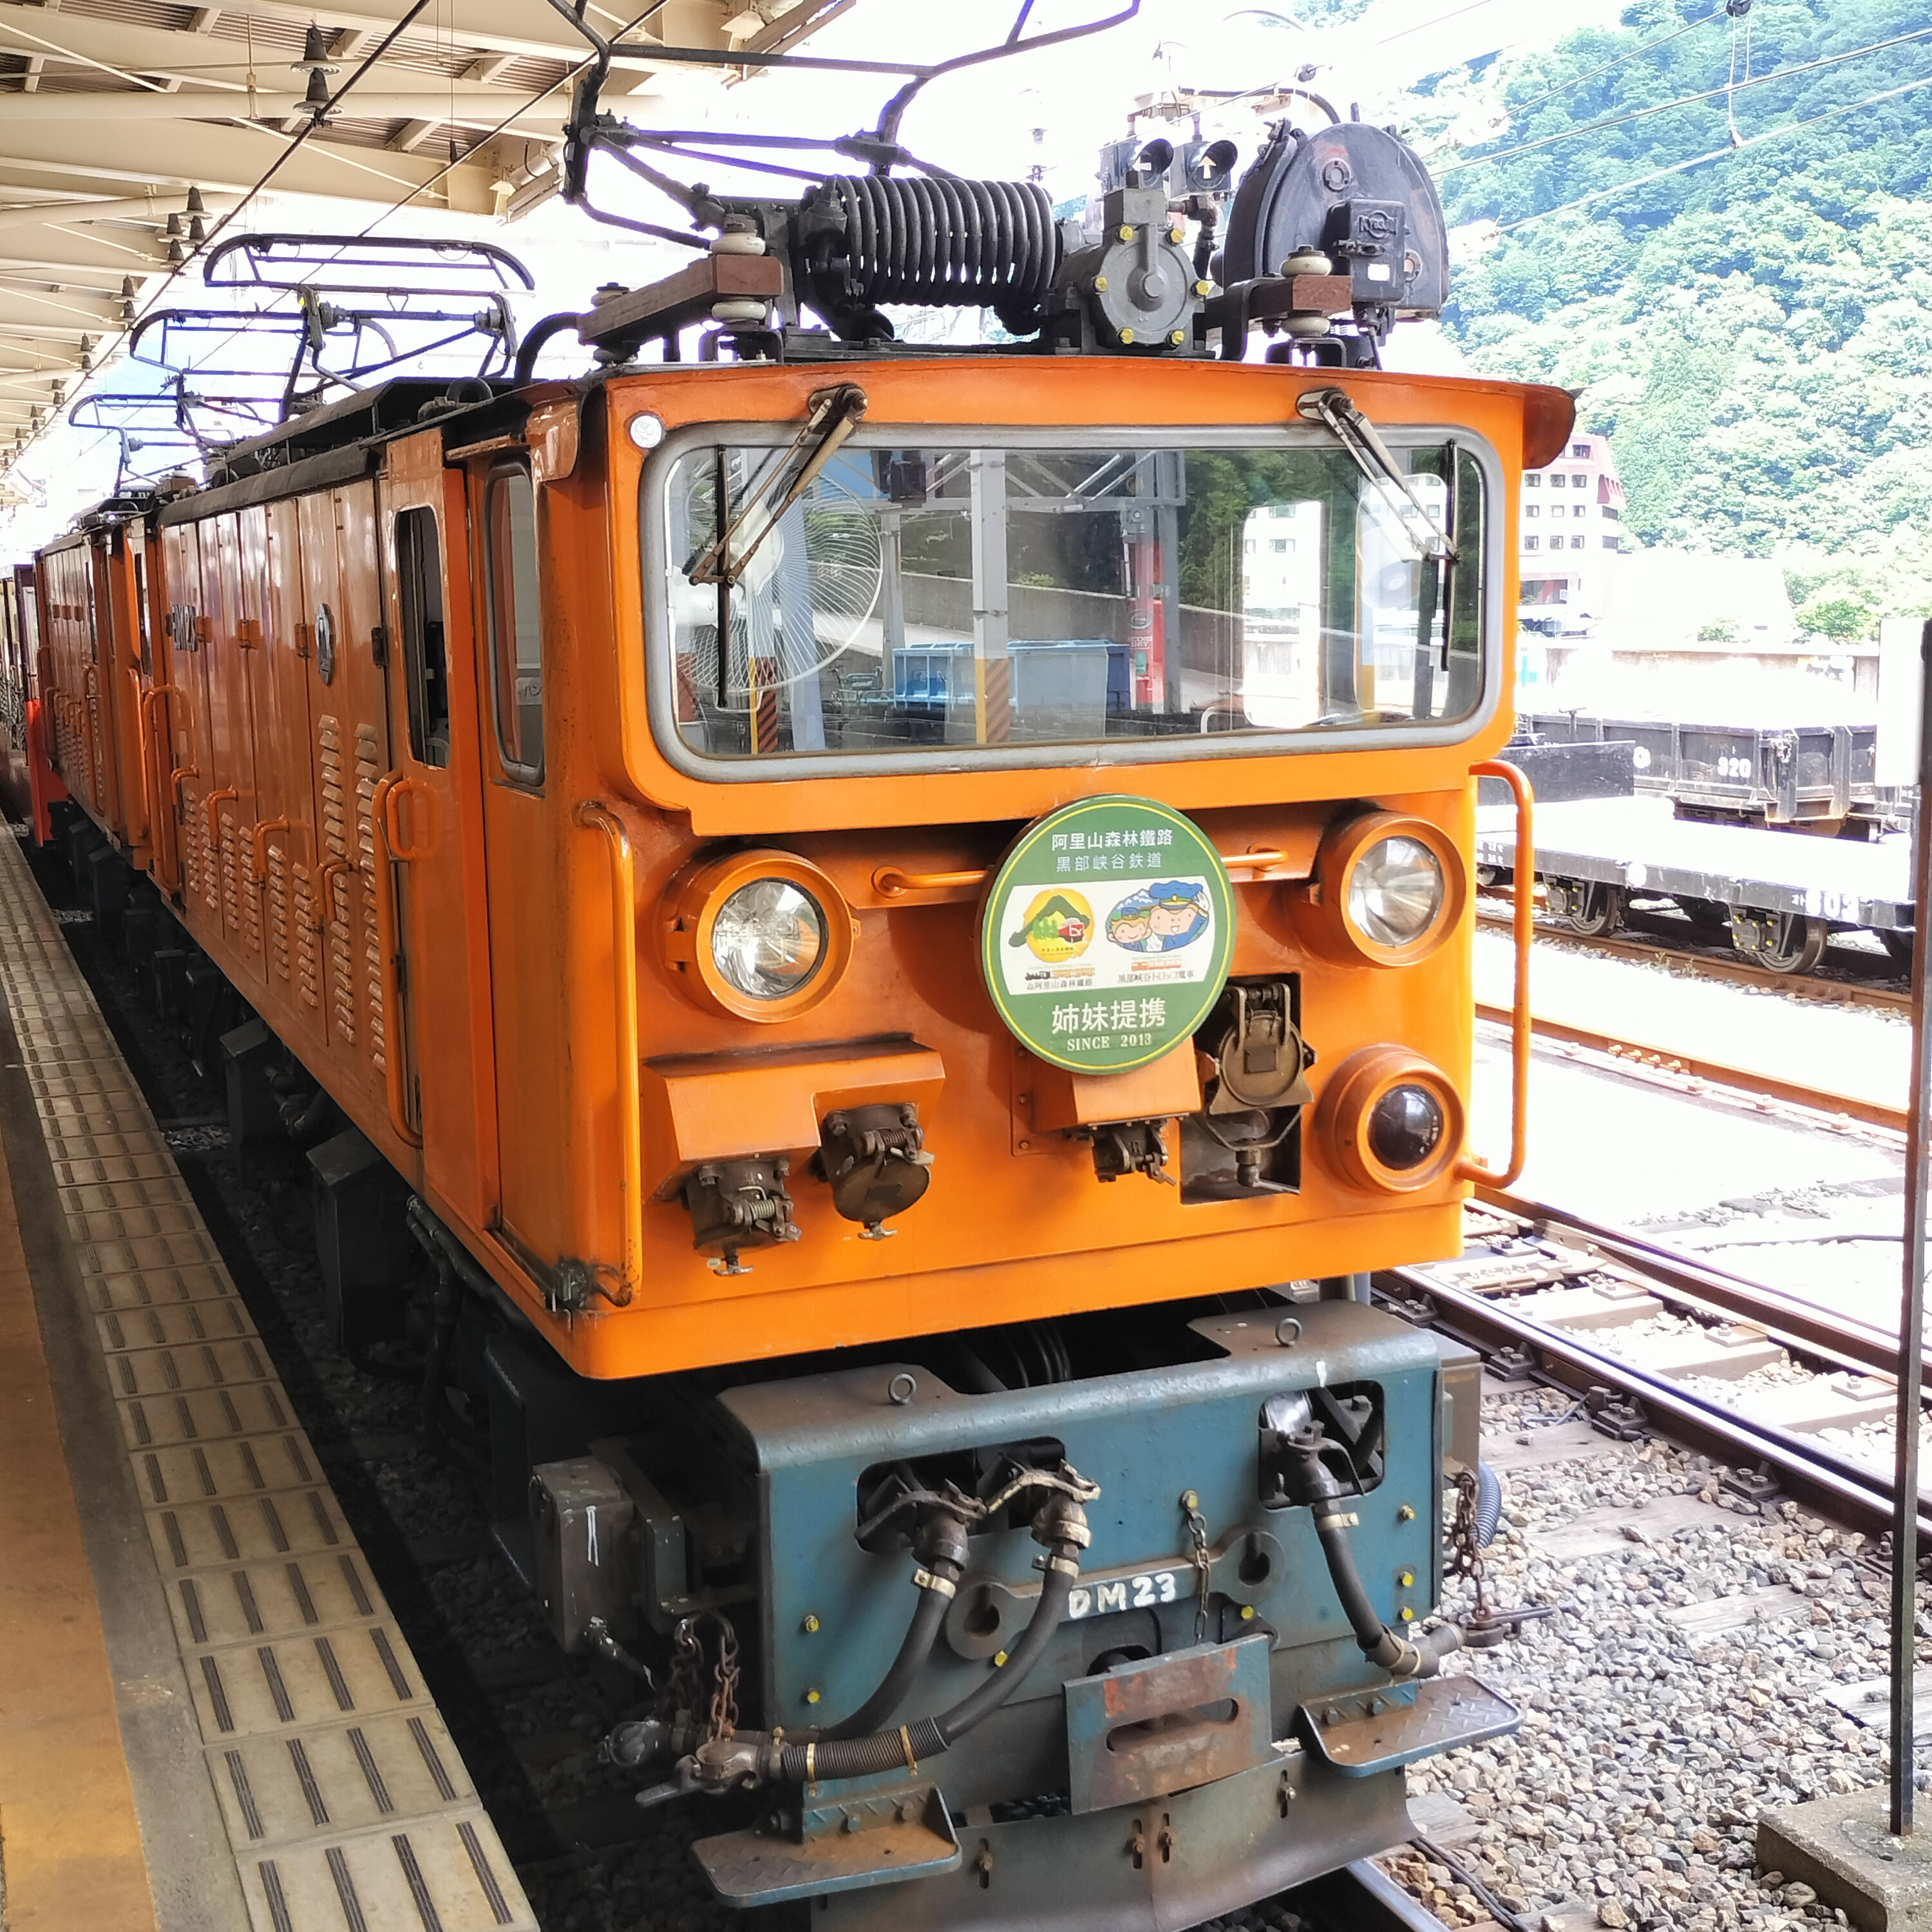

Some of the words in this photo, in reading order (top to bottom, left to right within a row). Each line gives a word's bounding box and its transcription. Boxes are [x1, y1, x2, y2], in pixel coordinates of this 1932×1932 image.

[1052, 829, 1173, 851] 阿里山森林鐵路
[1056, 852, 1162, 873] 黒部峡谷鉄道
[1052, 997, 1166, 1034] 姉妹提携
[1066, 1036, 1110, 1052] SINCE
[1120, 1033, 1153, 1047] 2013
[1068, 1573, 1176, 1619] DM23
